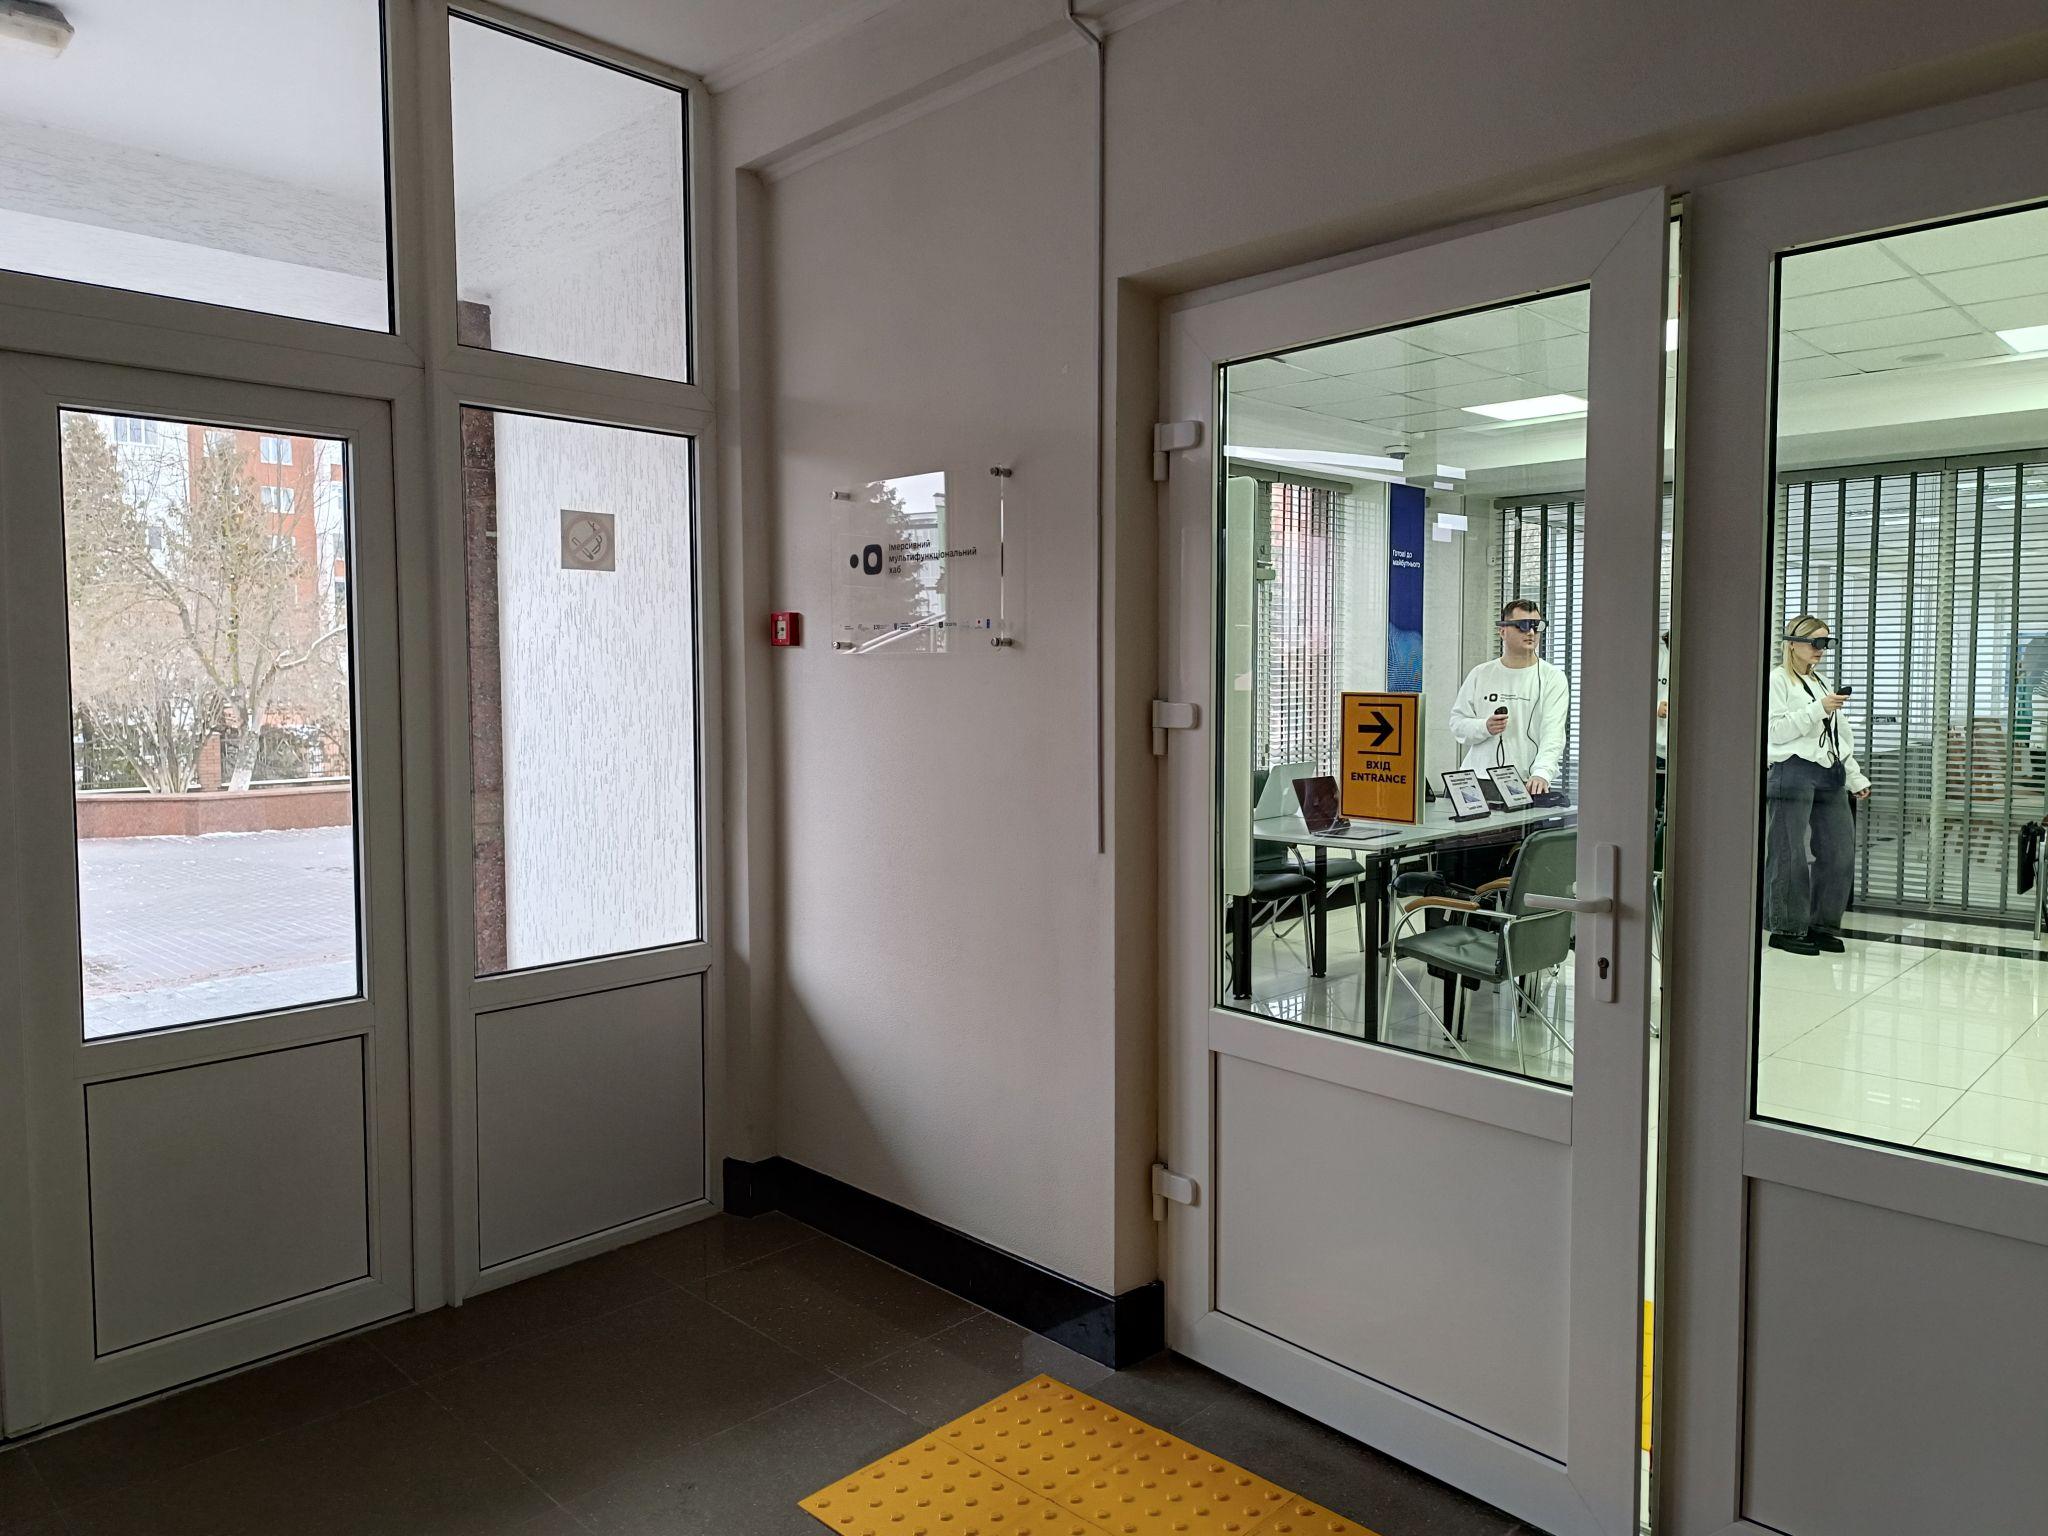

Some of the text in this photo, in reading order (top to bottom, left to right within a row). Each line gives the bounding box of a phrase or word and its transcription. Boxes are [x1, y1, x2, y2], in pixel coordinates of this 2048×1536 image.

[888, 539, 931, 551] Імерсивний
[888, 547, 977, 563] мультифункціональний
[888, 565, 902, 574] хаб
[1366, 760, 1391, 772] ВХІД
[1351, 772, 1407, 784] ENTRANCE
